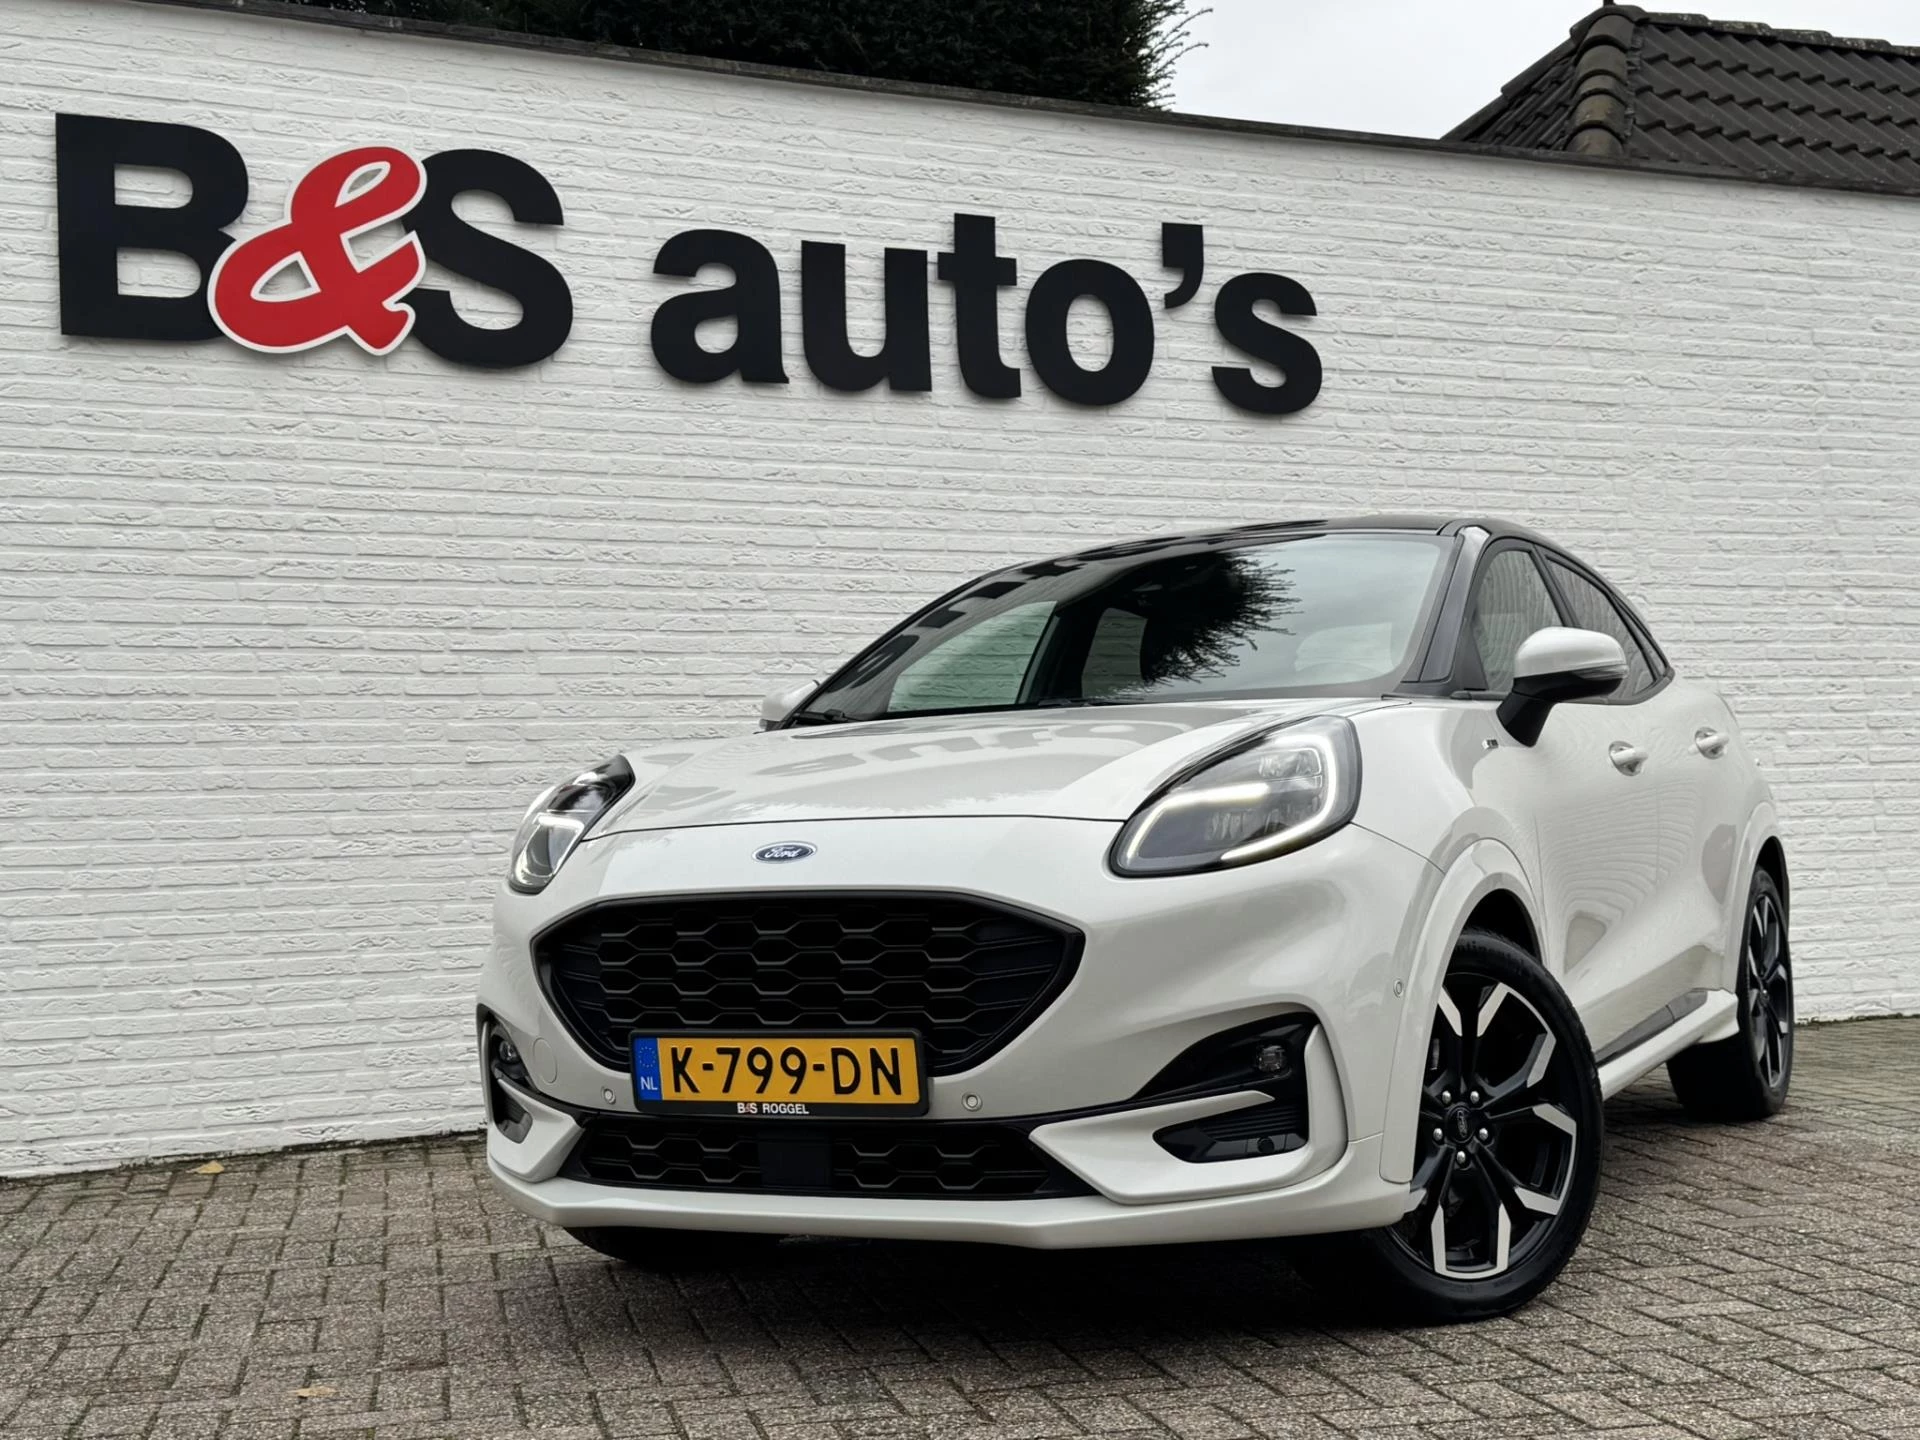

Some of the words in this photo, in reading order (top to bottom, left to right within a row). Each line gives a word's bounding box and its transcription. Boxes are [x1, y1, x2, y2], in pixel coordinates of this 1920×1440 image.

[55, 113, 574, 369] B&S
[650, 213, 1323, 415] auto's
[764, 846, 803, 858] Ford
[670, 1046, 902, 1096] K-799-DN
[640, 1076, 659, 1091] NL
[762, 1103, 810, 1115] ROGGEL
